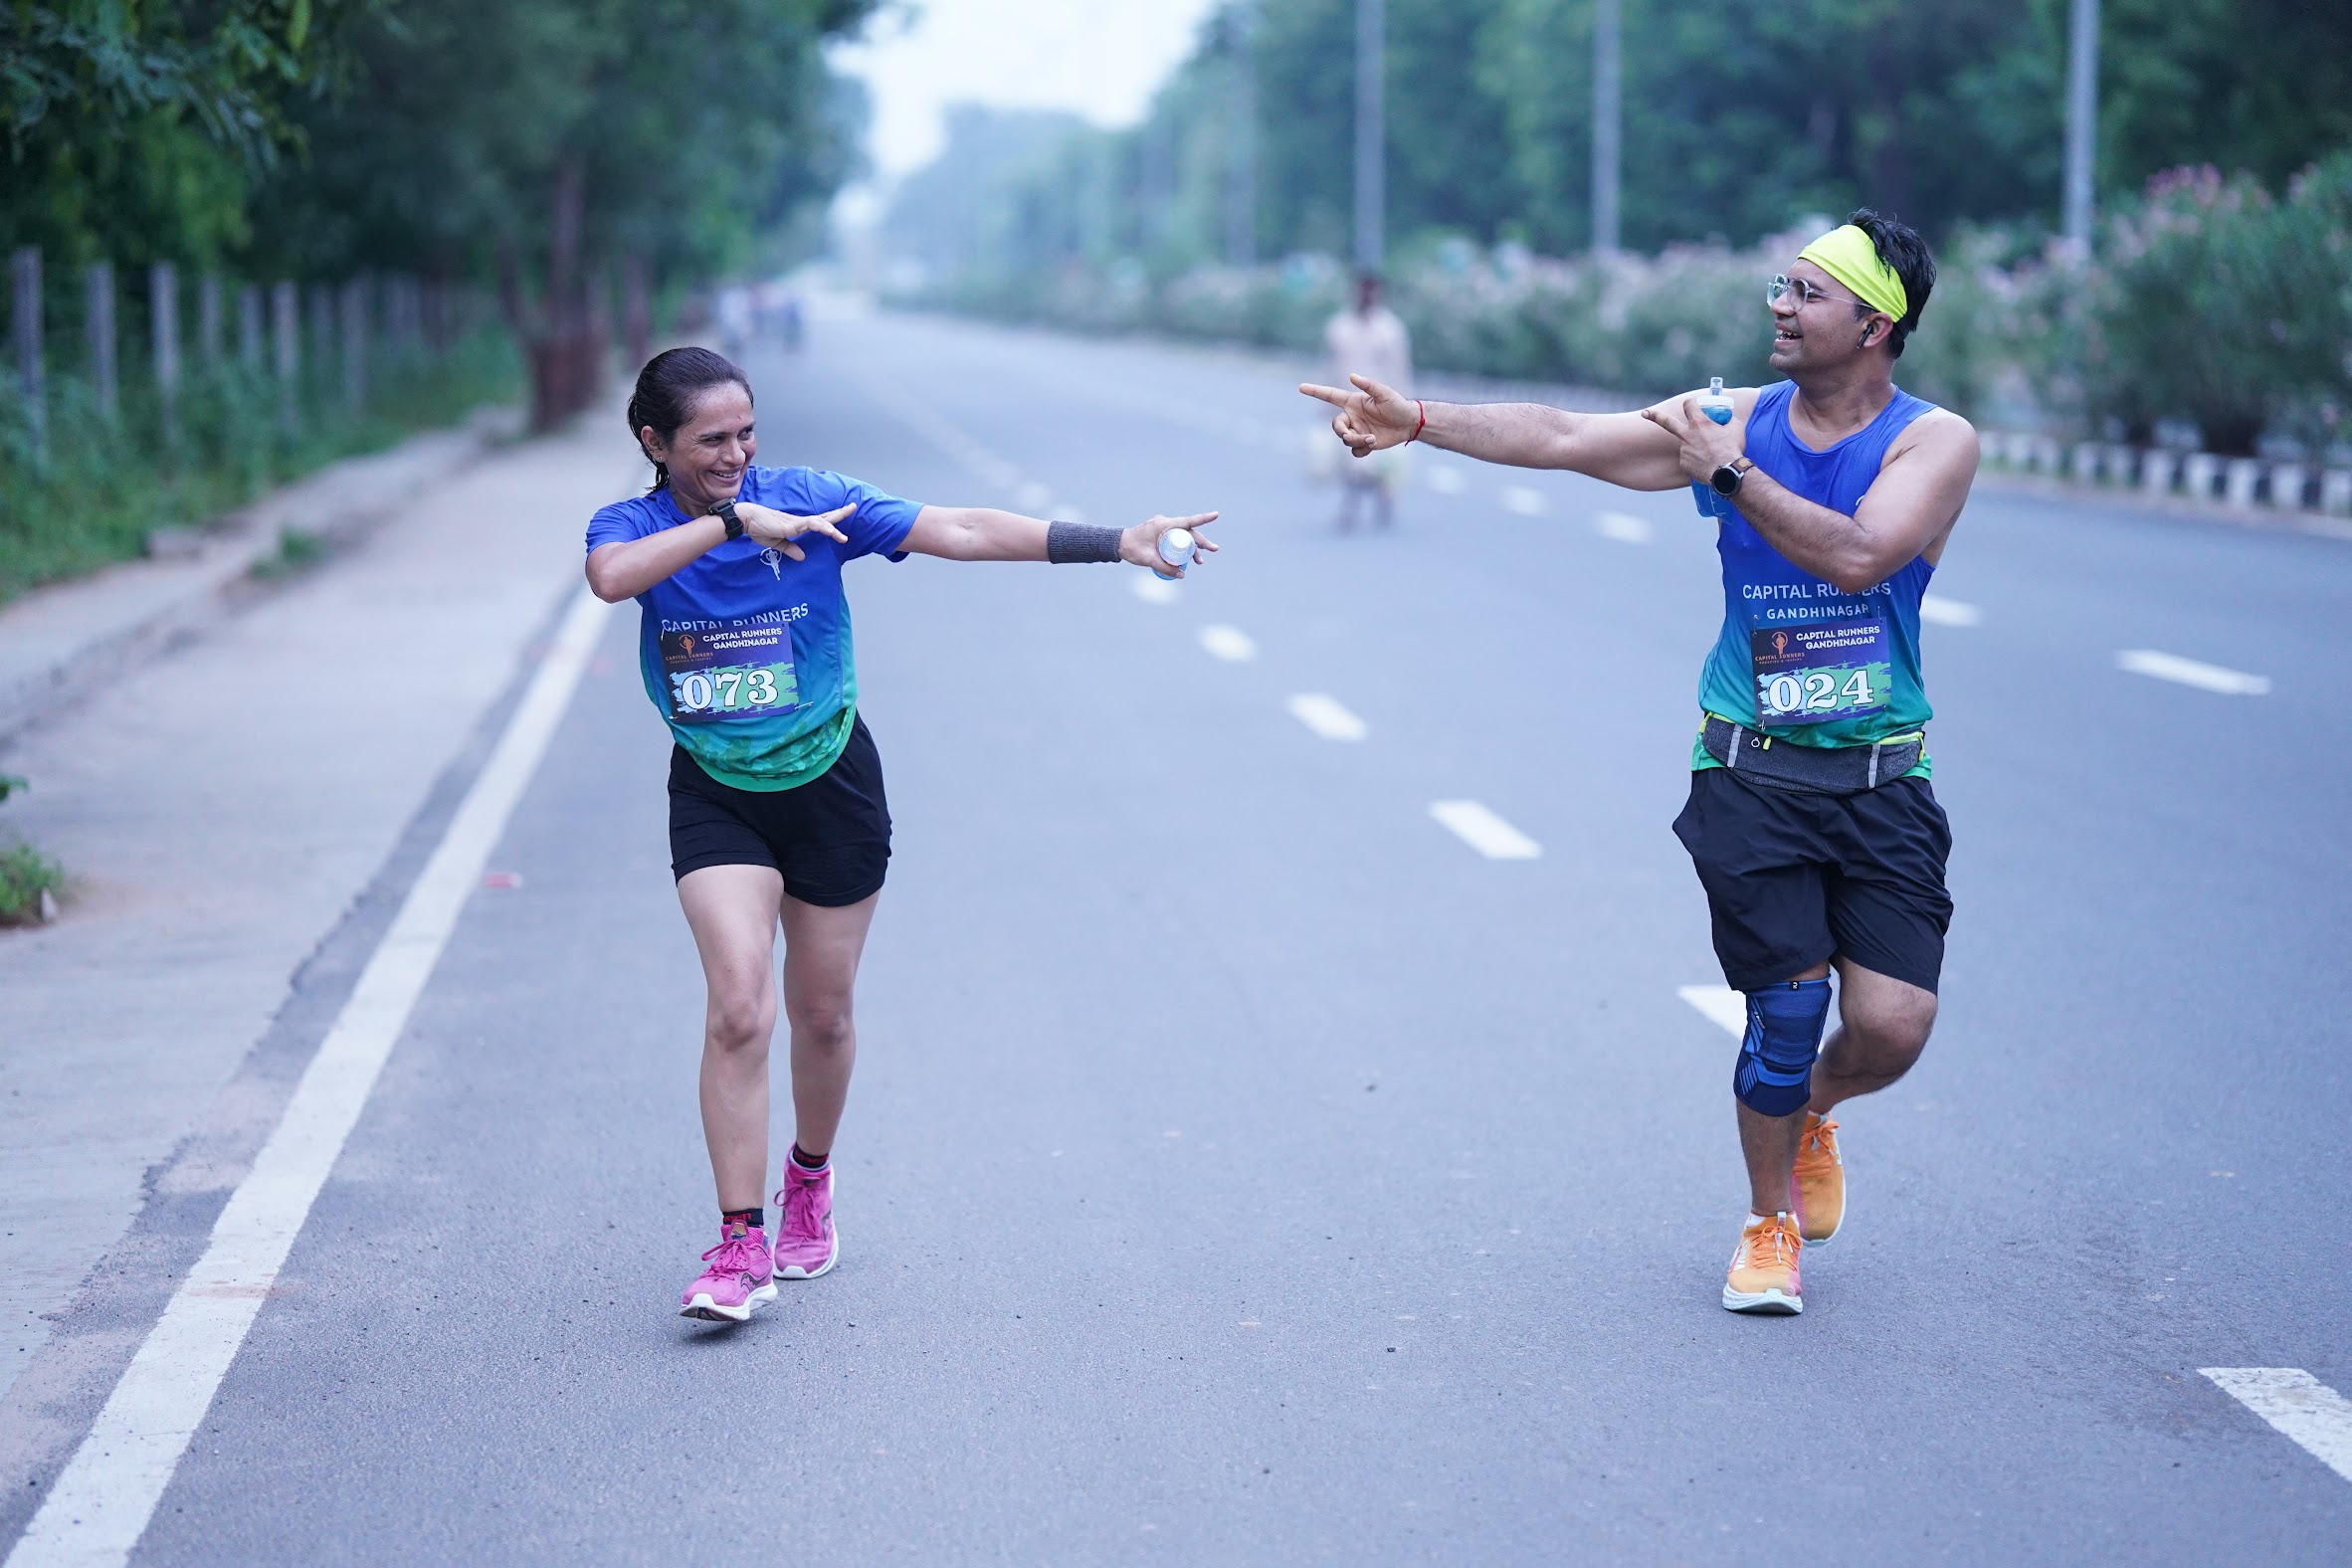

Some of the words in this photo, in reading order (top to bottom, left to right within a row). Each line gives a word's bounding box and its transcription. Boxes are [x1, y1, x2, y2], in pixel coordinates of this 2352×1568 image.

[1742, 584, 1813, 600] CAPITAL
[1817, 582, 1891, 597] RUERS
[1766, 603, 1869, 619] GANDHINAGAR
[702, 631, 740, 643] CAPITAL
[741, 627, 782, 639] RUNNERS
[1796, 630, 1836, 642] CAPITAL
[1837, 626, 1880, 638] RUNNERS
[712, 637, 778, 650] GANDHINAGAR
[1805, 636, 1875, 650] GANDHINAGAR
[682, 669, 778, 710] 073
[1769, 669, 1874, 712] 024
